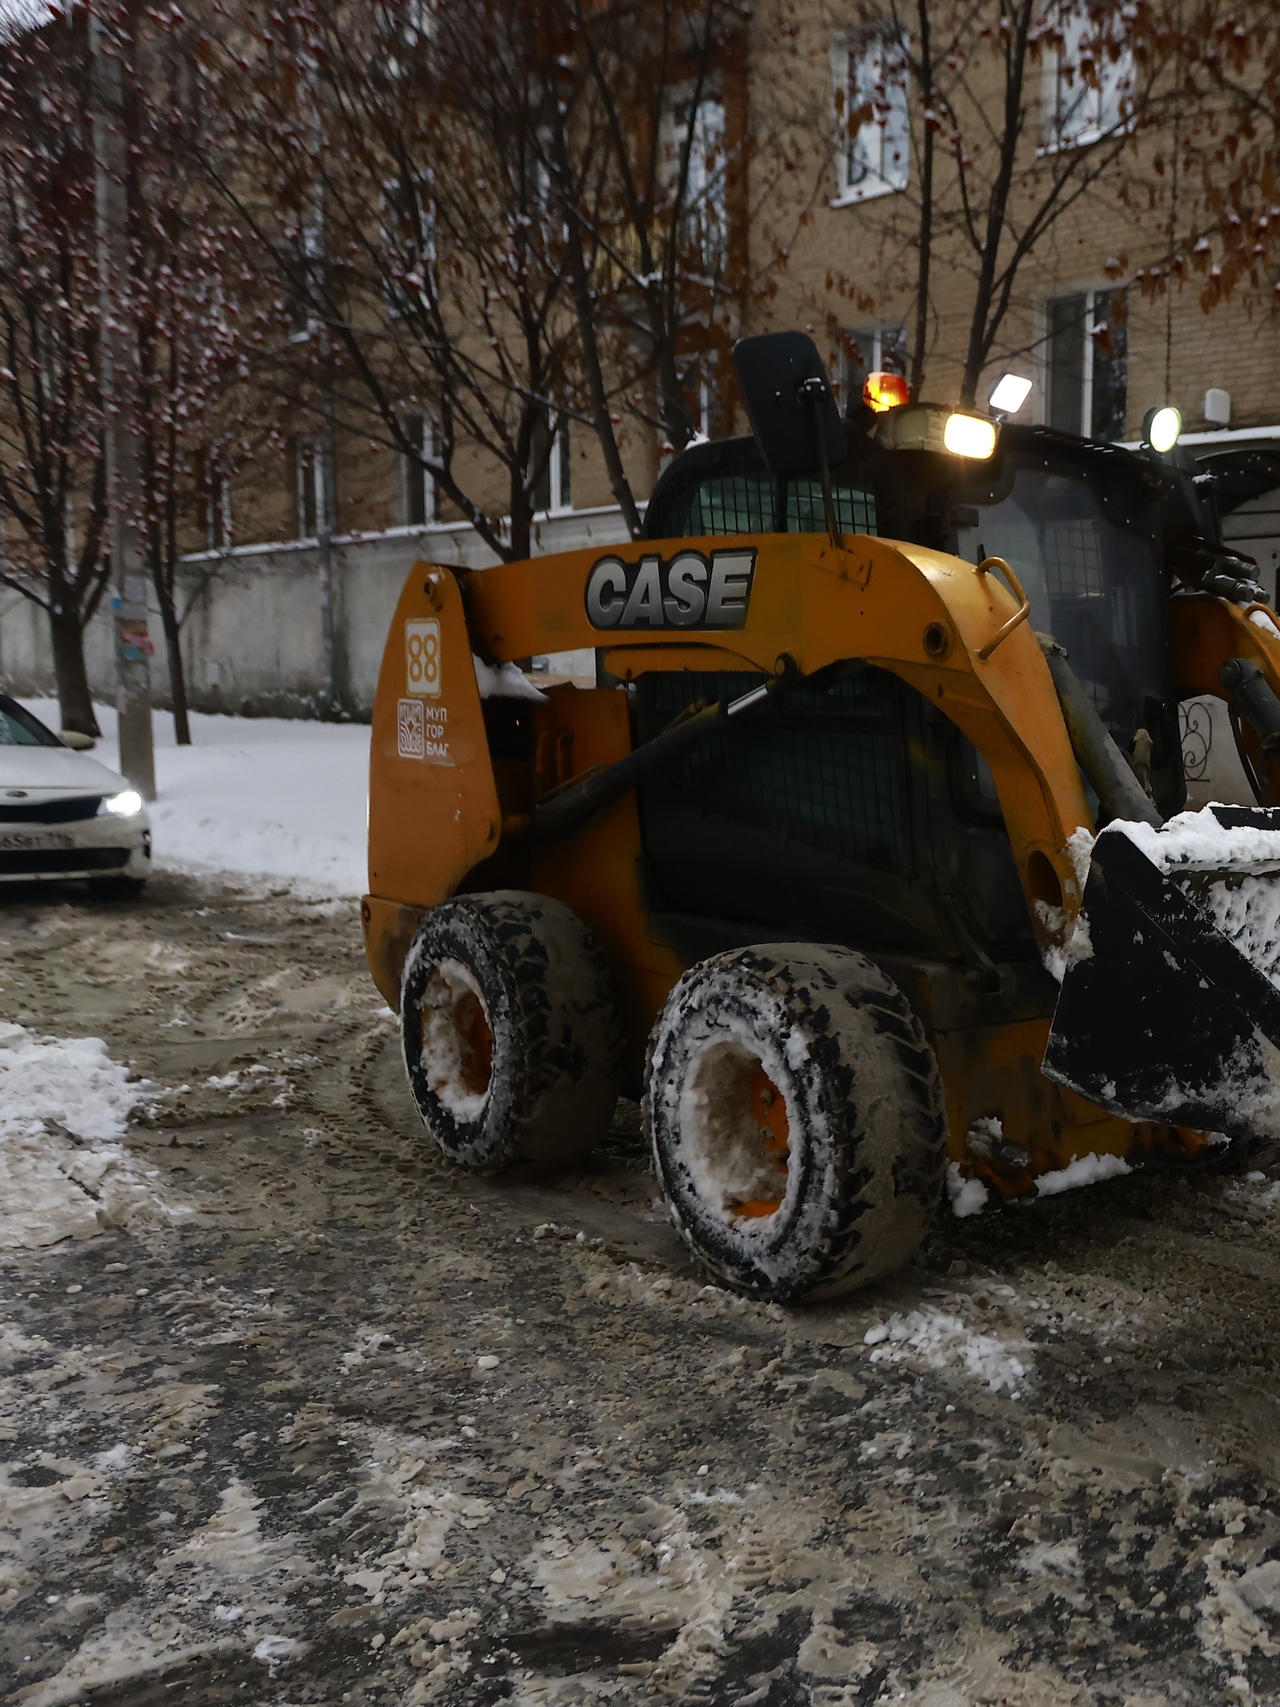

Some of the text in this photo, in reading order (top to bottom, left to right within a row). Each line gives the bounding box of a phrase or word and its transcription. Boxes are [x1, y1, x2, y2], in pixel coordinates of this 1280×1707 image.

[587, 553, 753, 627] CASE
[408, 634, 437, 683] 88
[426, 707, 447, 722] МУП
[426, 724, 443, 739] ГОР
[426, 741, 449, 756] БЛАГ
